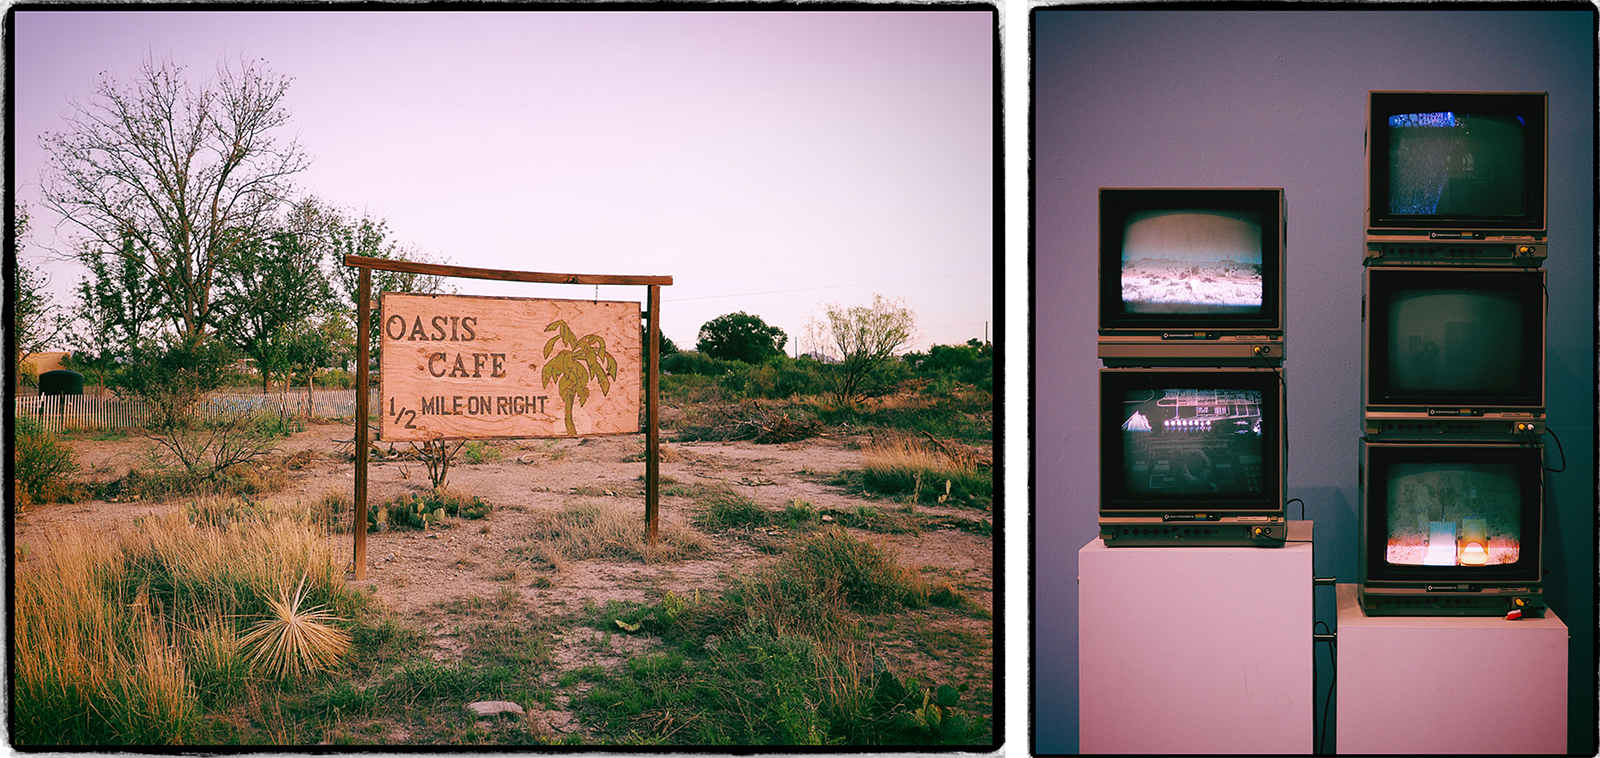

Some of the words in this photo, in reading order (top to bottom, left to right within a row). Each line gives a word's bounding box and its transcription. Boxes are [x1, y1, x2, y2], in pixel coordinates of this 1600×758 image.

[386, 315, 478, 341] OASIS
[428, 353, 506, 377] CAFE
[389, 397, 417, 429] 1/2
[422, 396, 463, 415] MILE
[468, 396, 492, 415] ON
[497, 396, 548, 415] RIGHT
